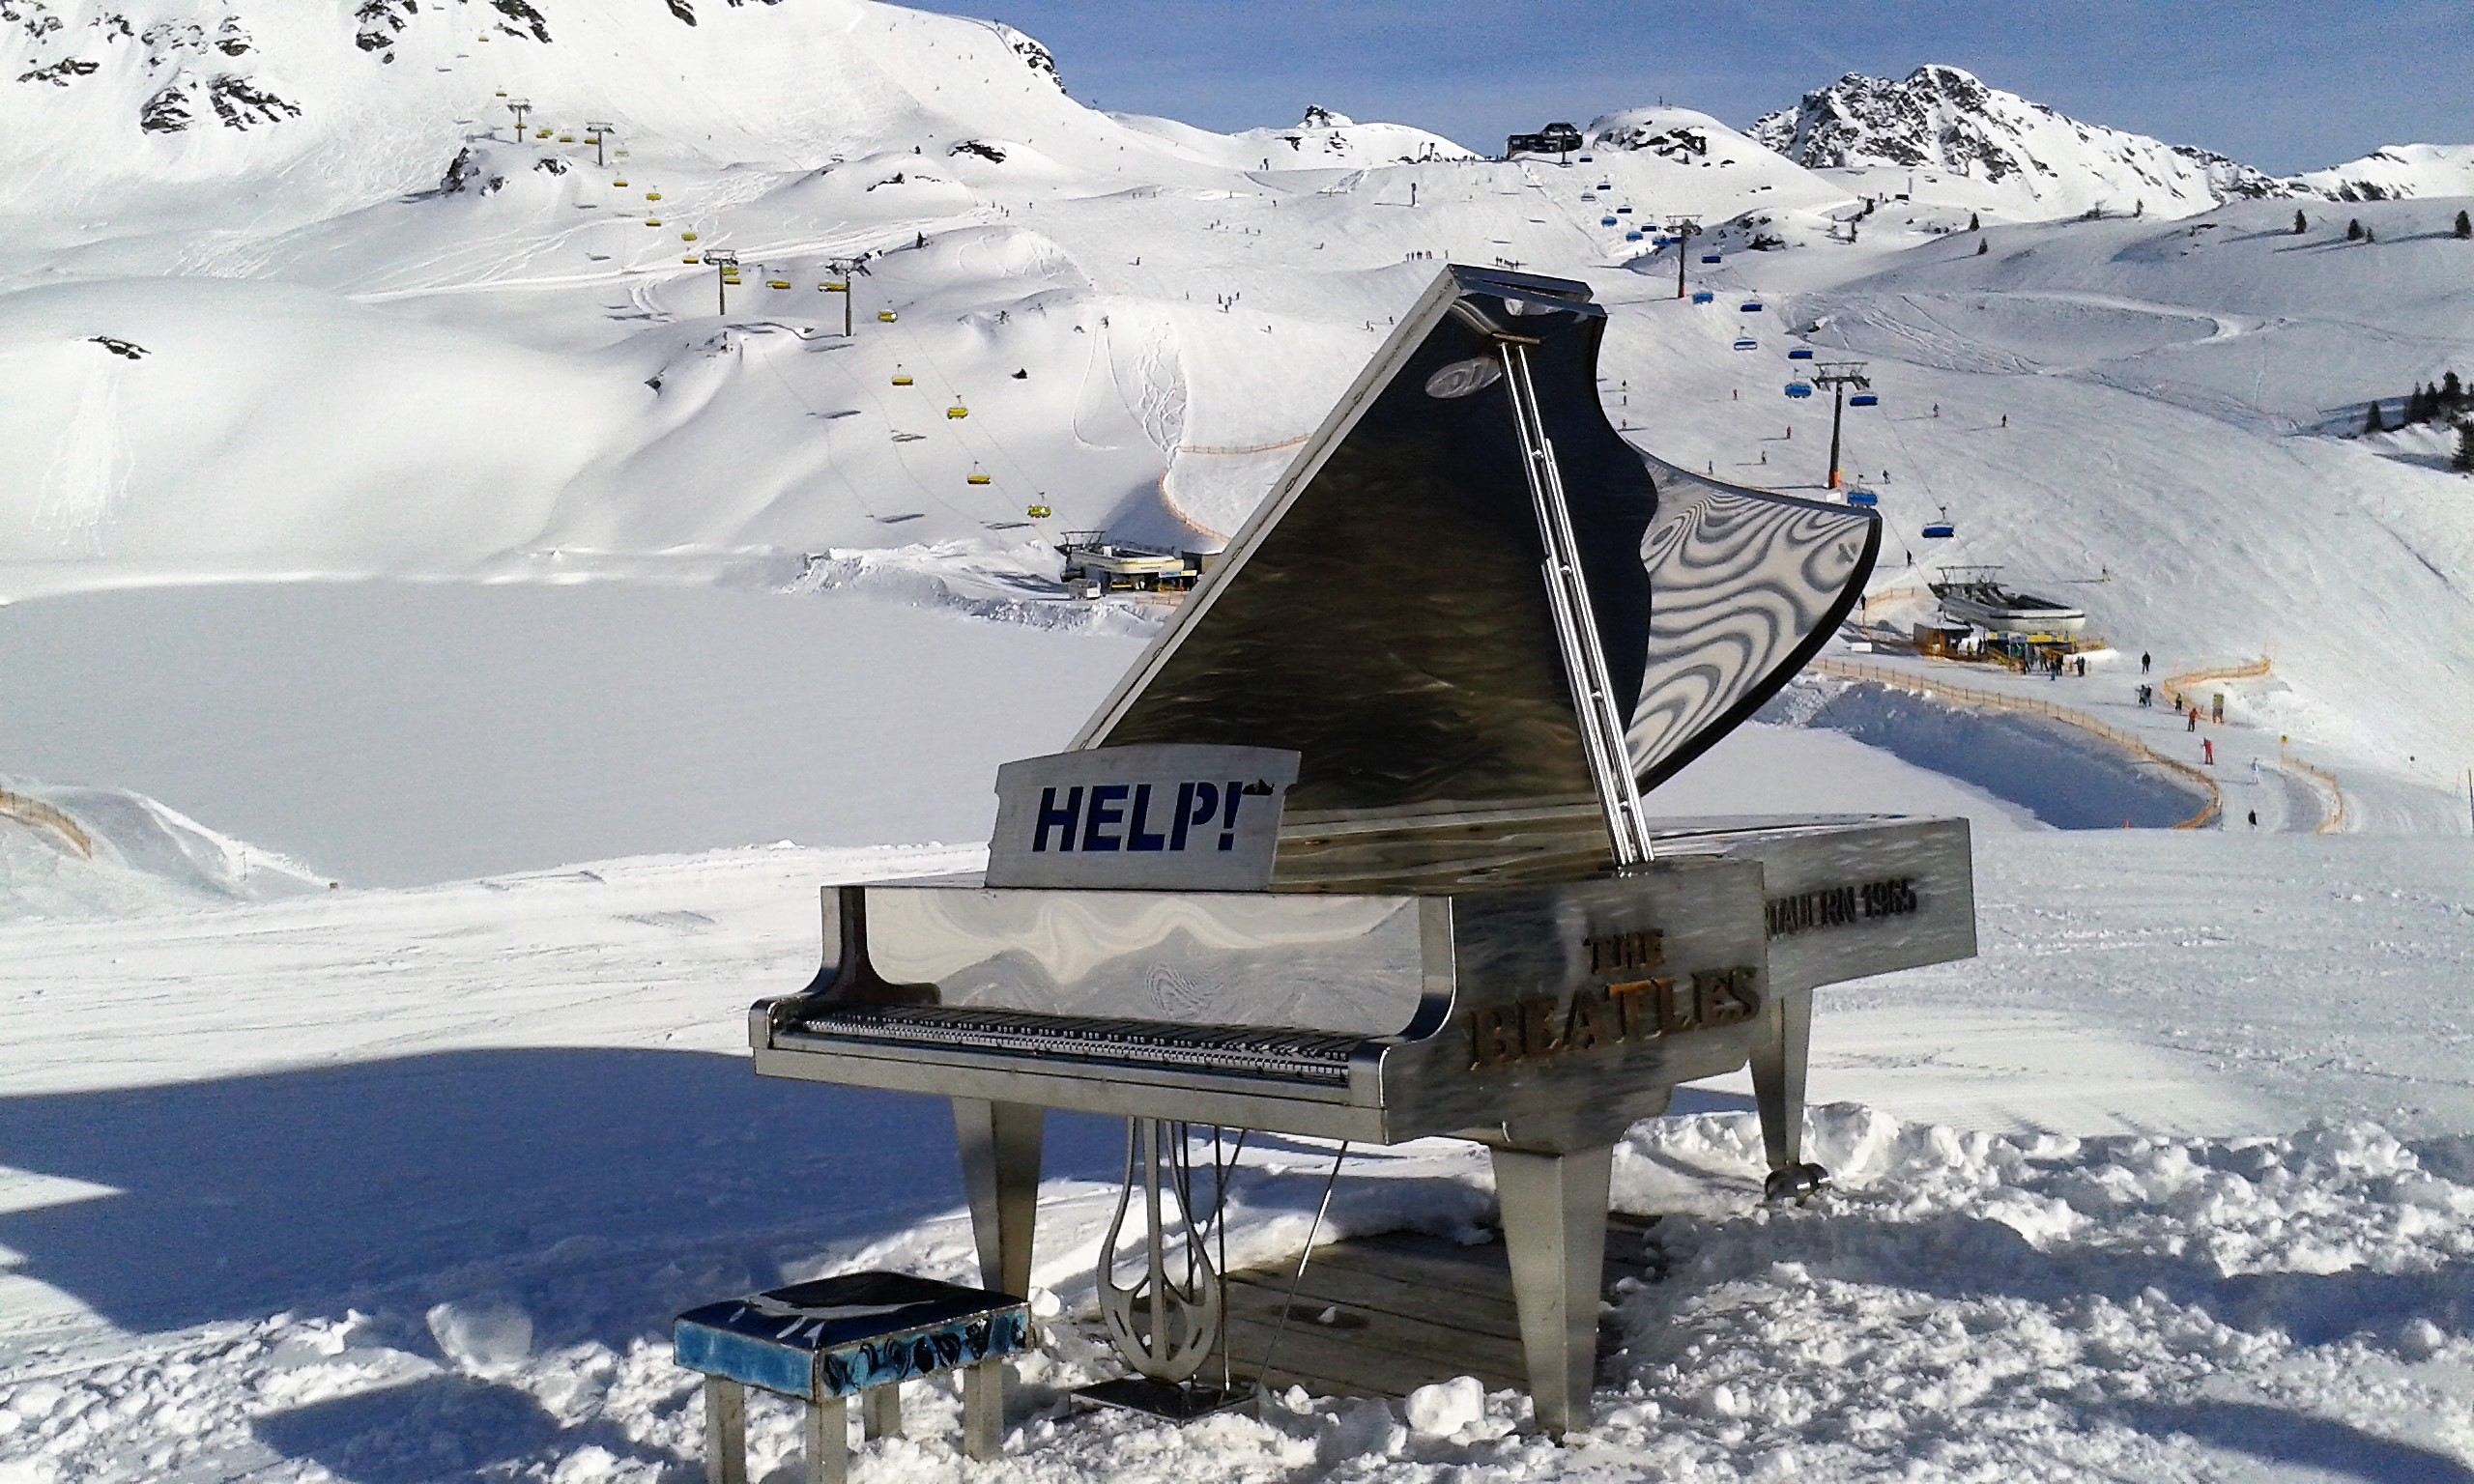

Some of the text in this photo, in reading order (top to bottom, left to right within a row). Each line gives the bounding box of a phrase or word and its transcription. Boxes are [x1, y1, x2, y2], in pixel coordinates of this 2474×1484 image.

[1032, 781, 1244, 852] HELP!
[1765, 877, 1917, 935] TAUERN 1965
[1582, 928, 1665, 975] THE
[1468, 966, 1761, 1070] BEATLES
